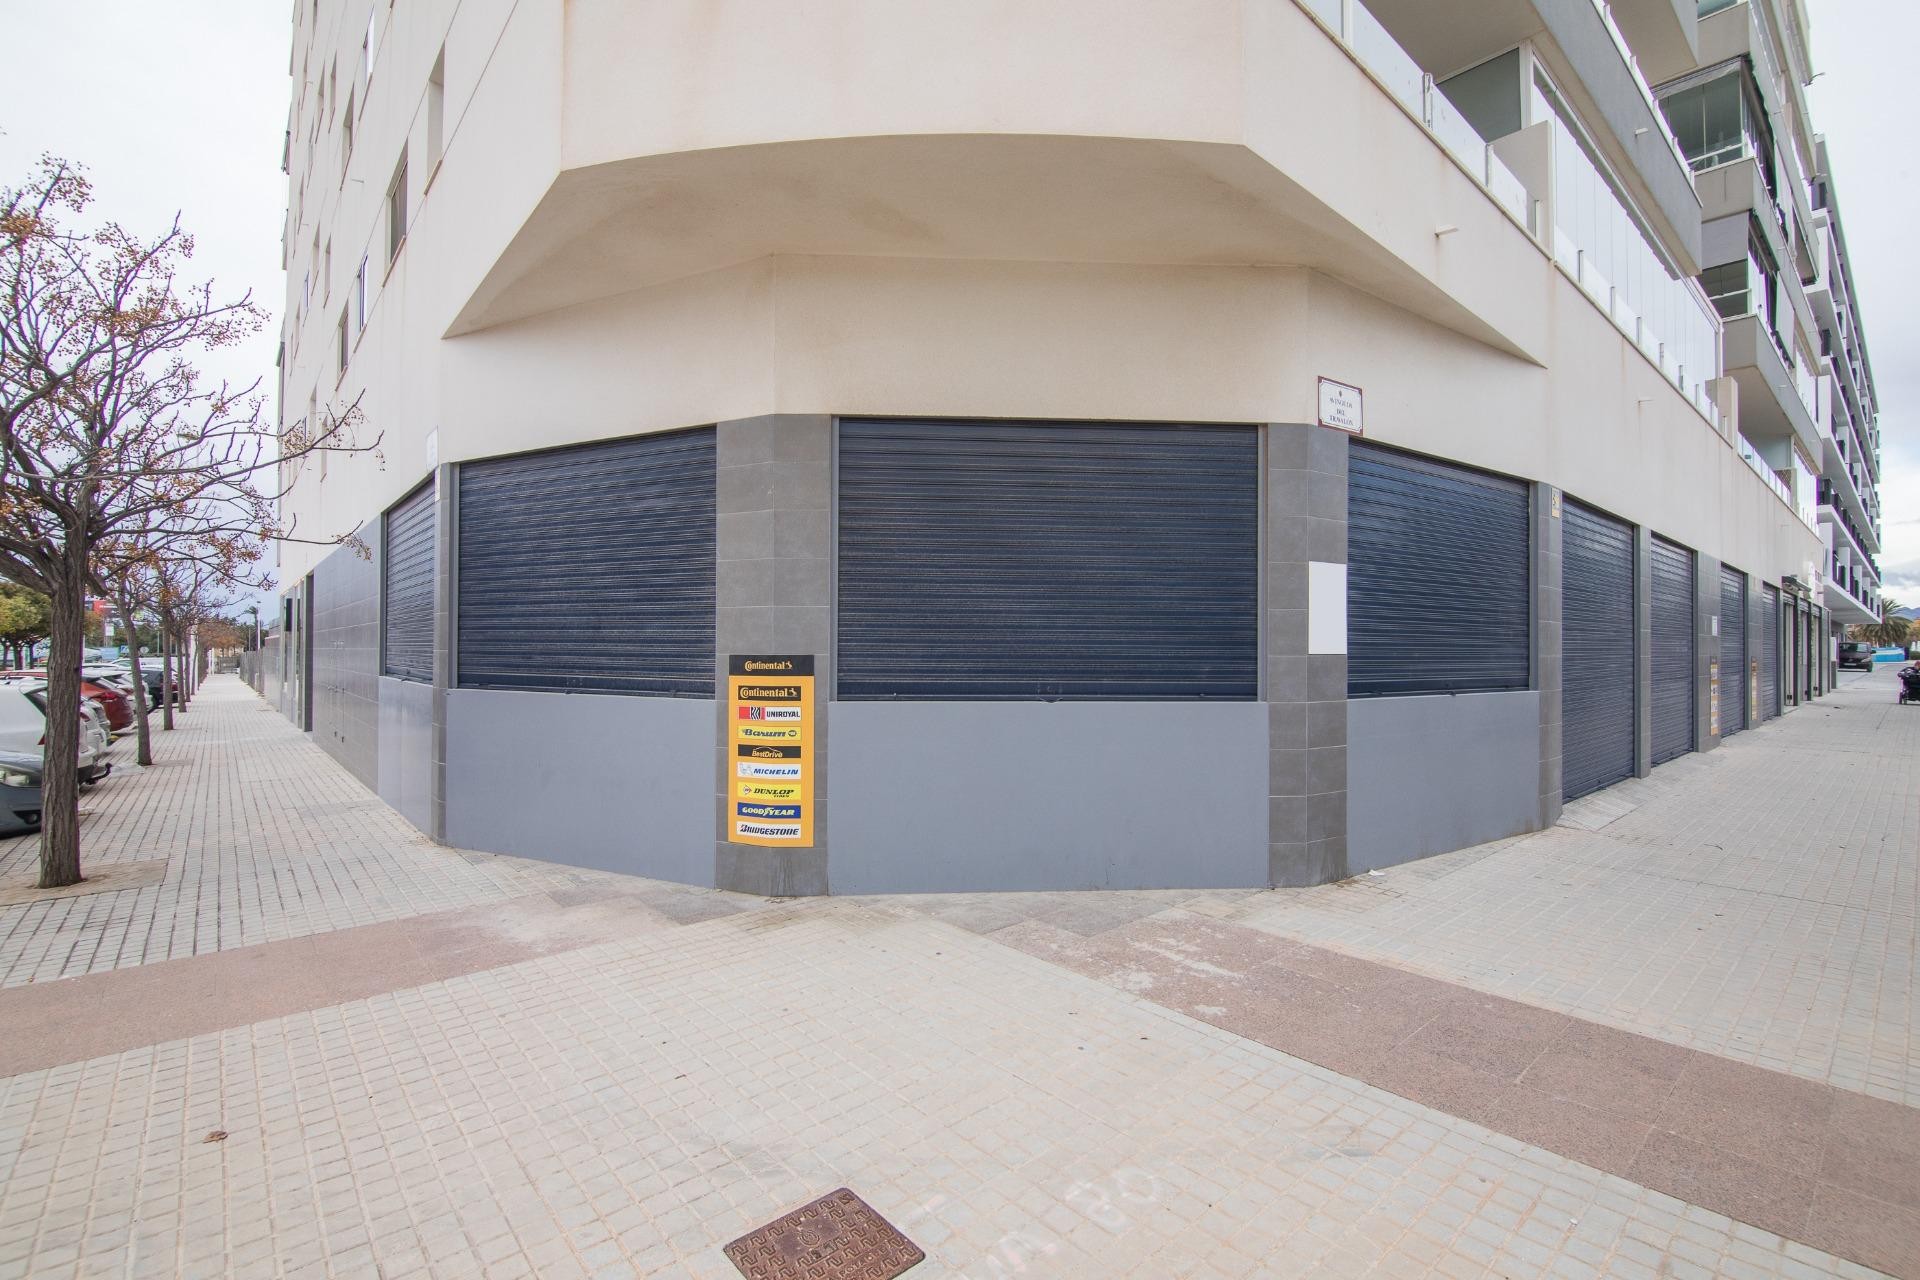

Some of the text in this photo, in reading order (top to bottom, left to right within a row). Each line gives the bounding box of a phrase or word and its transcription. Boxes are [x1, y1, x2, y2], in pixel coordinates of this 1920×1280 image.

[744, 660, 785, 672] Continental
[740, 687, 788, 698] Continental
[766, 710, 800, 718] UNIROYAL
[751, 750, 783, 758] BestDrive
[742, 807, 795, 816] GOODYEAR
[740, 824, 799, 835] BRIDGESTONE
